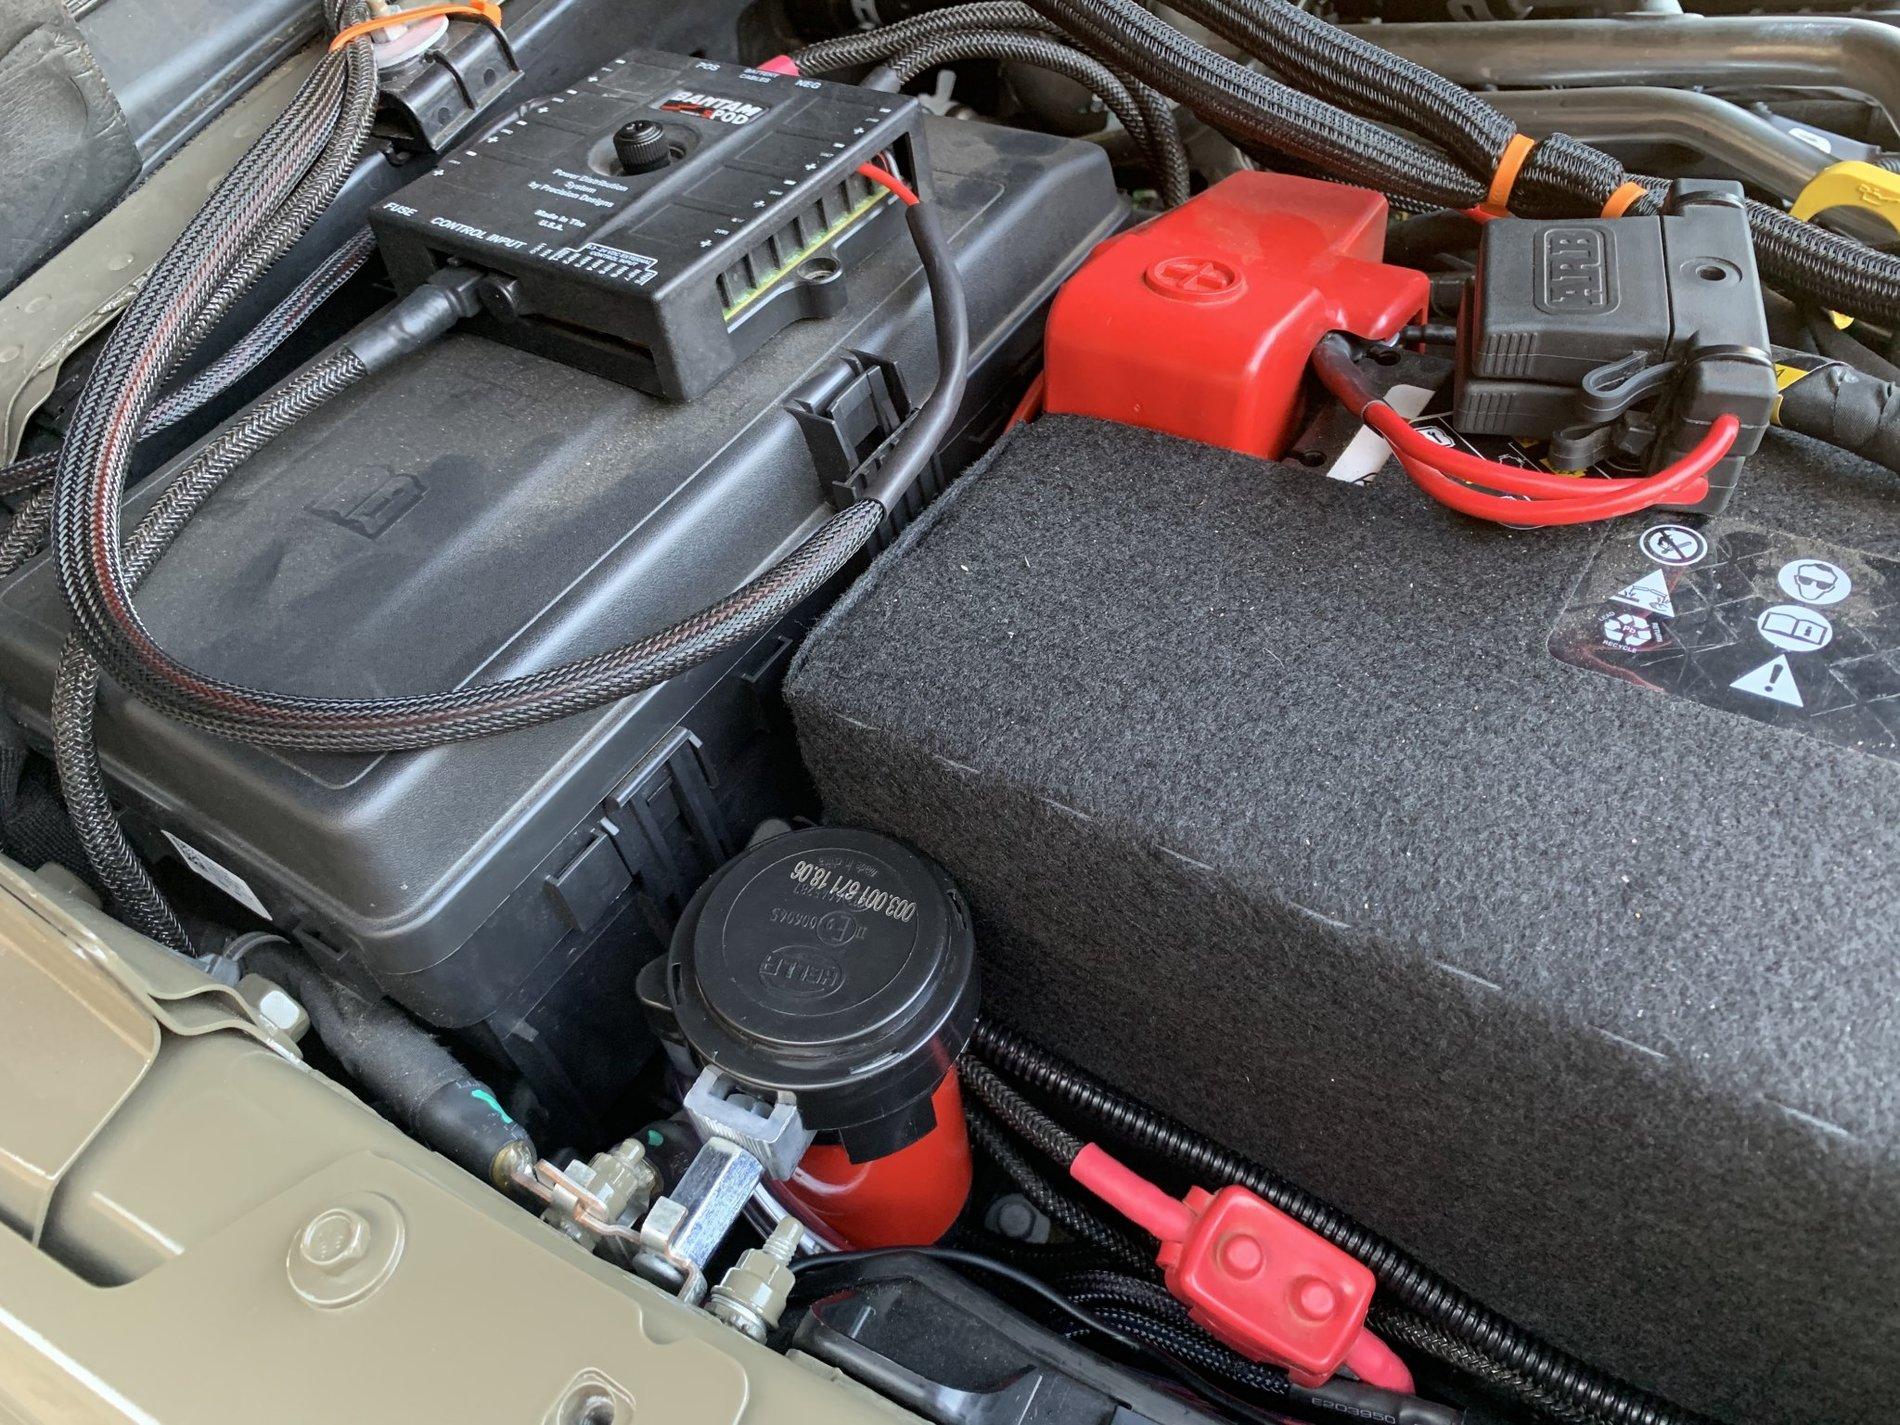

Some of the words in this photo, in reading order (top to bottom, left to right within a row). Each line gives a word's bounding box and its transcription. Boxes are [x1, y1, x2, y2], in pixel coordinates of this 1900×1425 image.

[695, 61, 721, 71] POS
[794, 79, 822, 90] NEG
[672, 90, 763, 117] BANTAM
[383, 201, 418, 217] FUSE
[430, 216, 488, 240] CONTROL
[486, 233, 528, 250] INPUT
[1602, 640, 1638, 654] RECYCLE
[790, 860, 832, 890] 18.06
